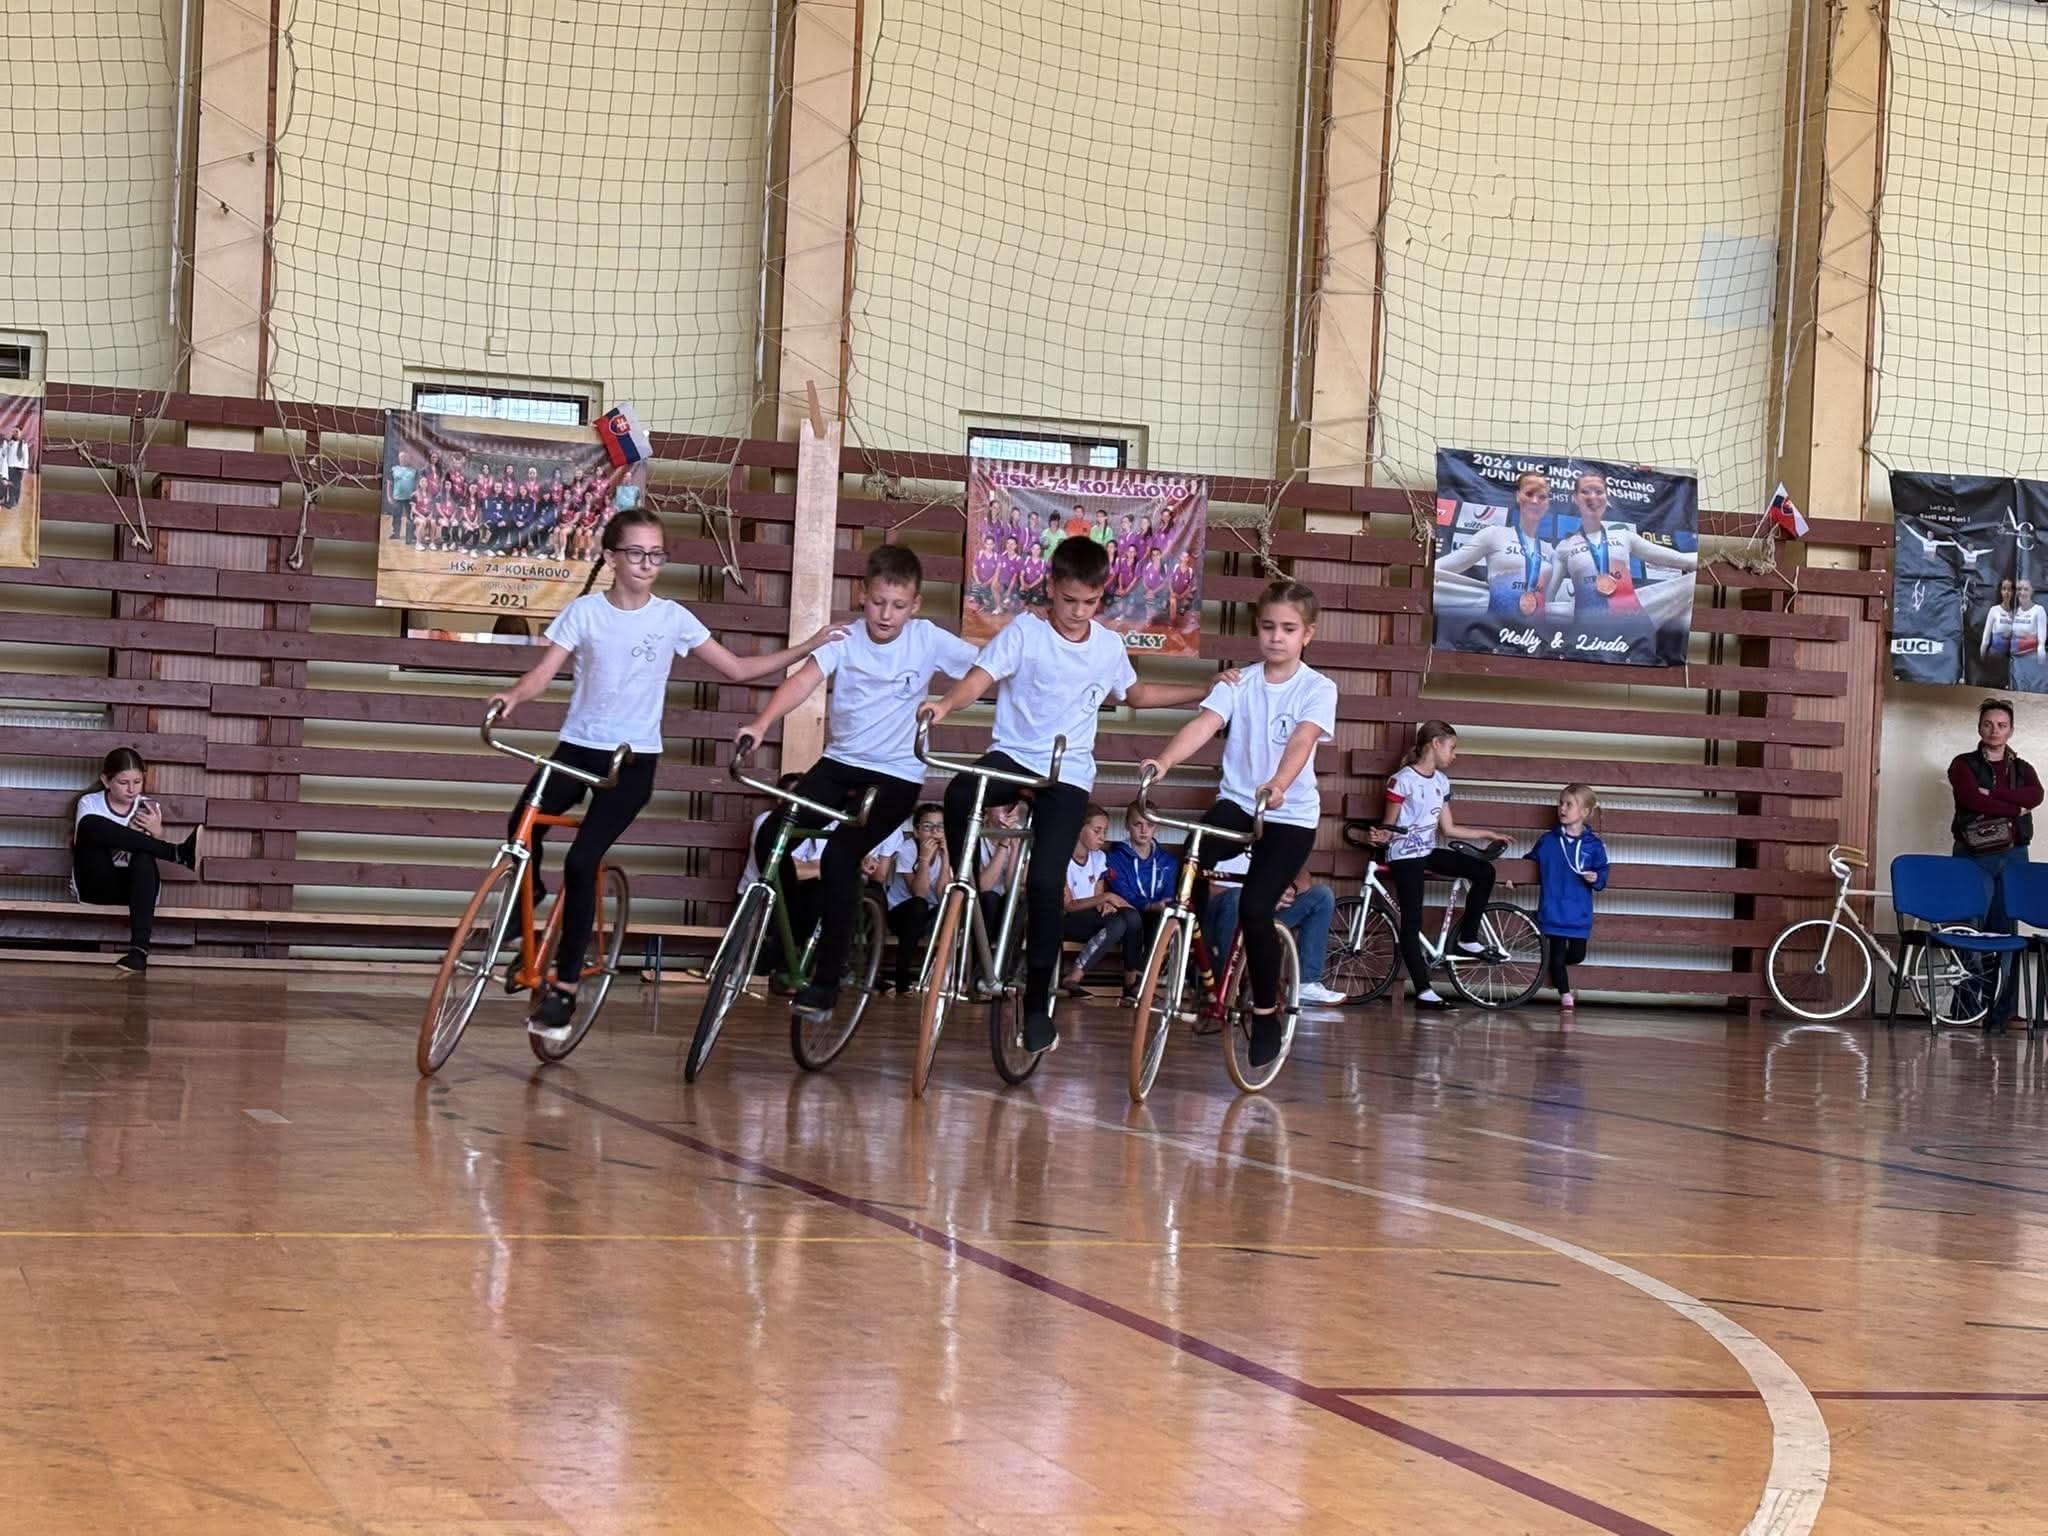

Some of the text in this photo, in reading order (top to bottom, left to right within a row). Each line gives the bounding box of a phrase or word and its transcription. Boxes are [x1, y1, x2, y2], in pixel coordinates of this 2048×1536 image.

[1472, 453, 1512, 470] 2026
[1549, 465, 1583, 479] INDO
[1606, 476, 1656, 493] CYCLING
[490, 593, 529, 607] 2021
[1499, 627, 1630, 654] Nelly & Linda
[1903, 640, 1933, 652] UCI
